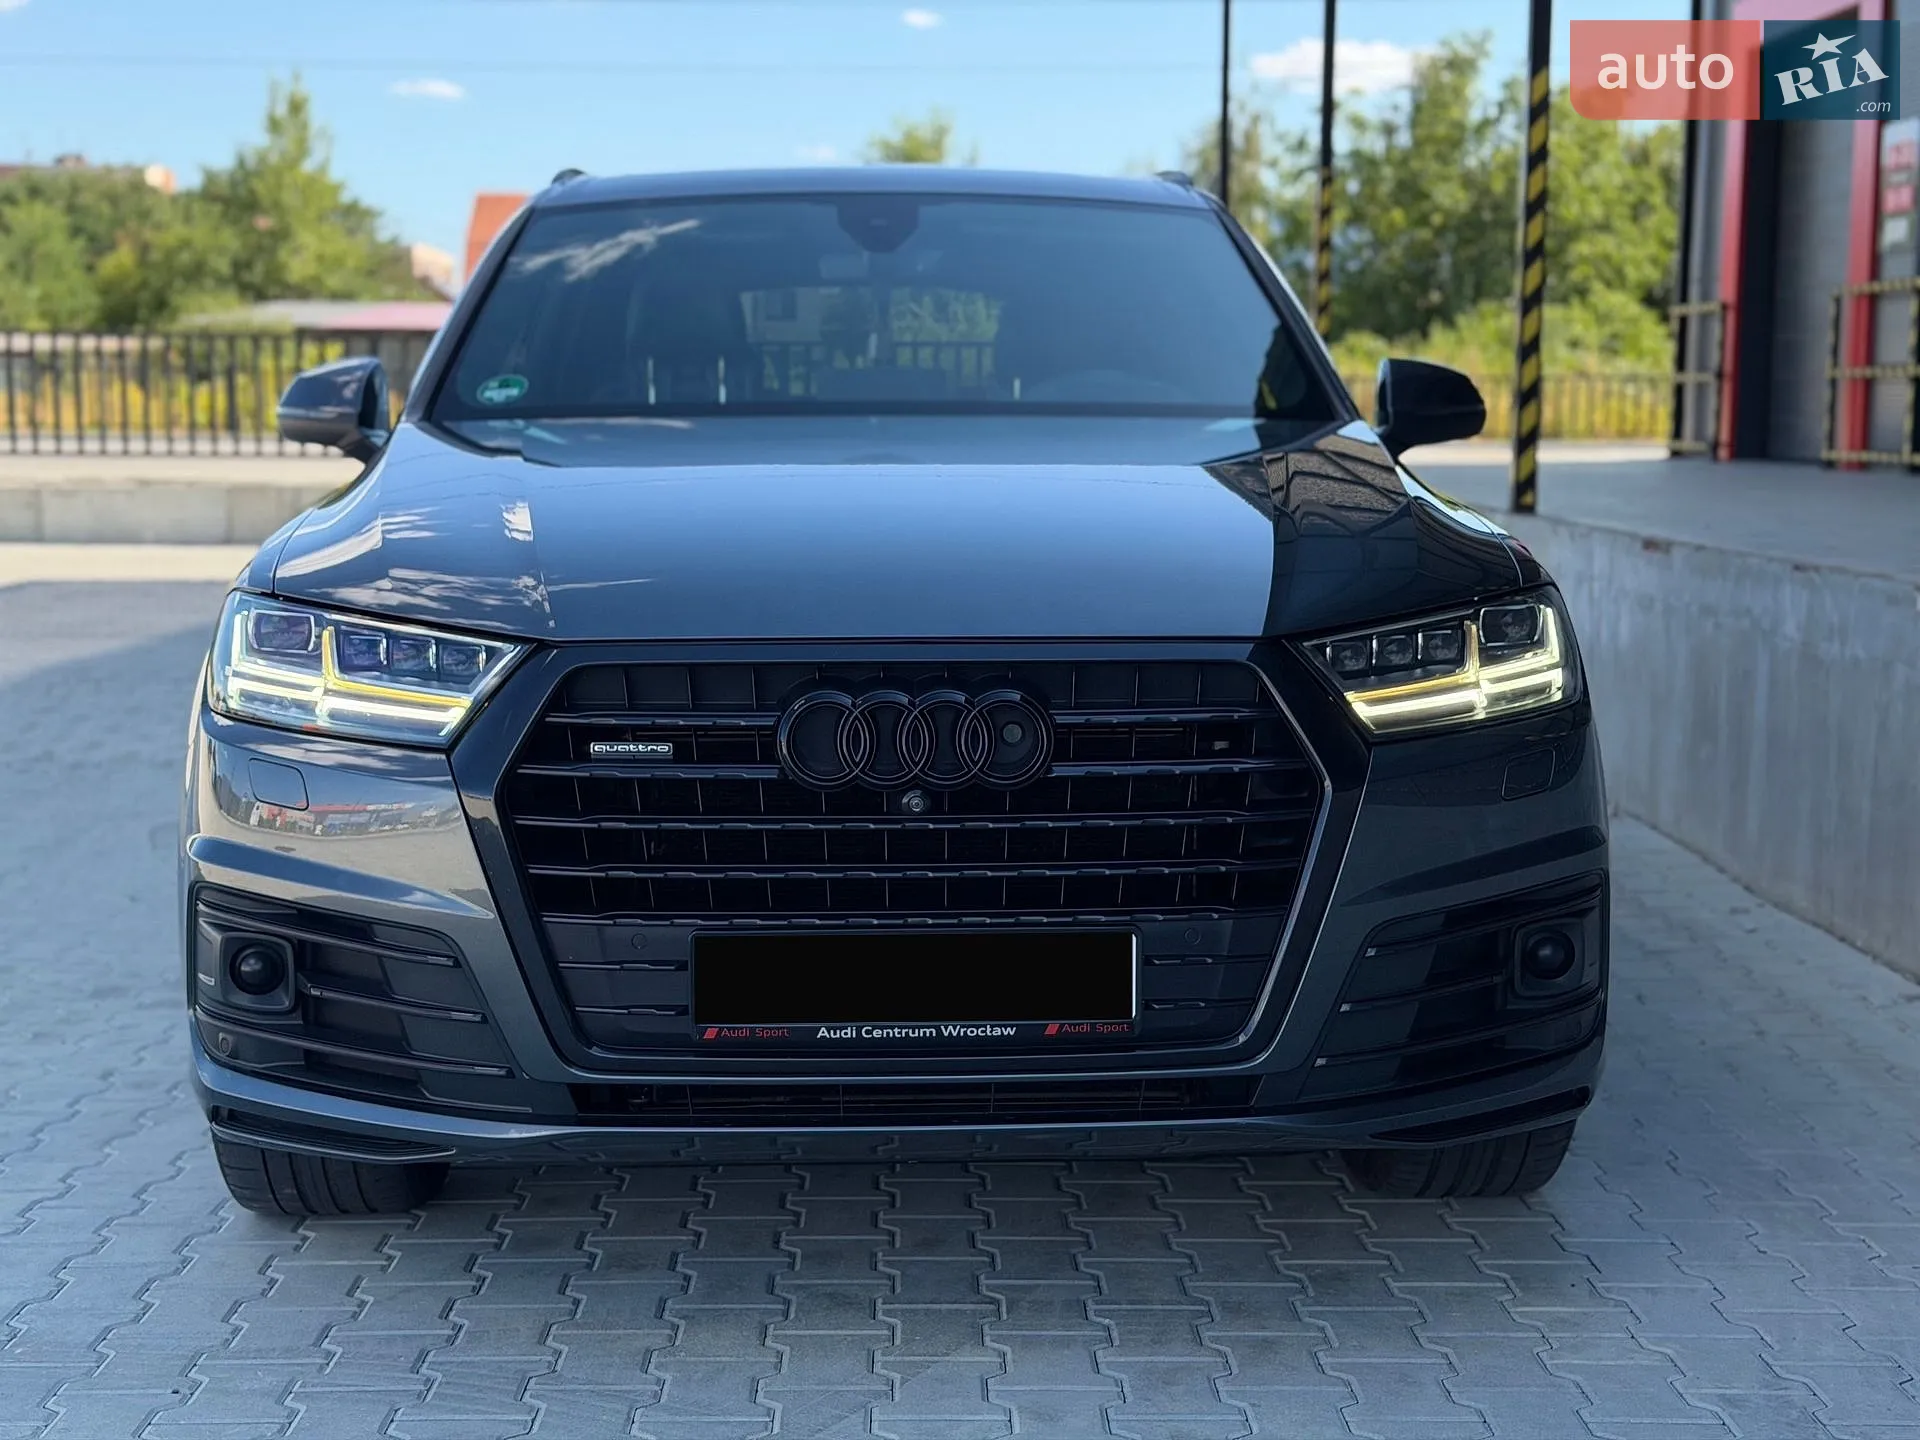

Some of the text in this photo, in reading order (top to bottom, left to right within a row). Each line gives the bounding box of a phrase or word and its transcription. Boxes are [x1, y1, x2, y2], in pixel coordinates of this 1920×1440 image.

[594, 744, 669, 753] quattro
[720, 1027, 790, 1039] Audi Sport
[816, 1024, 1017, 1039] Audi Centrum Wrocław
[1061, 1023, 1130, 1034] Audi Sport
